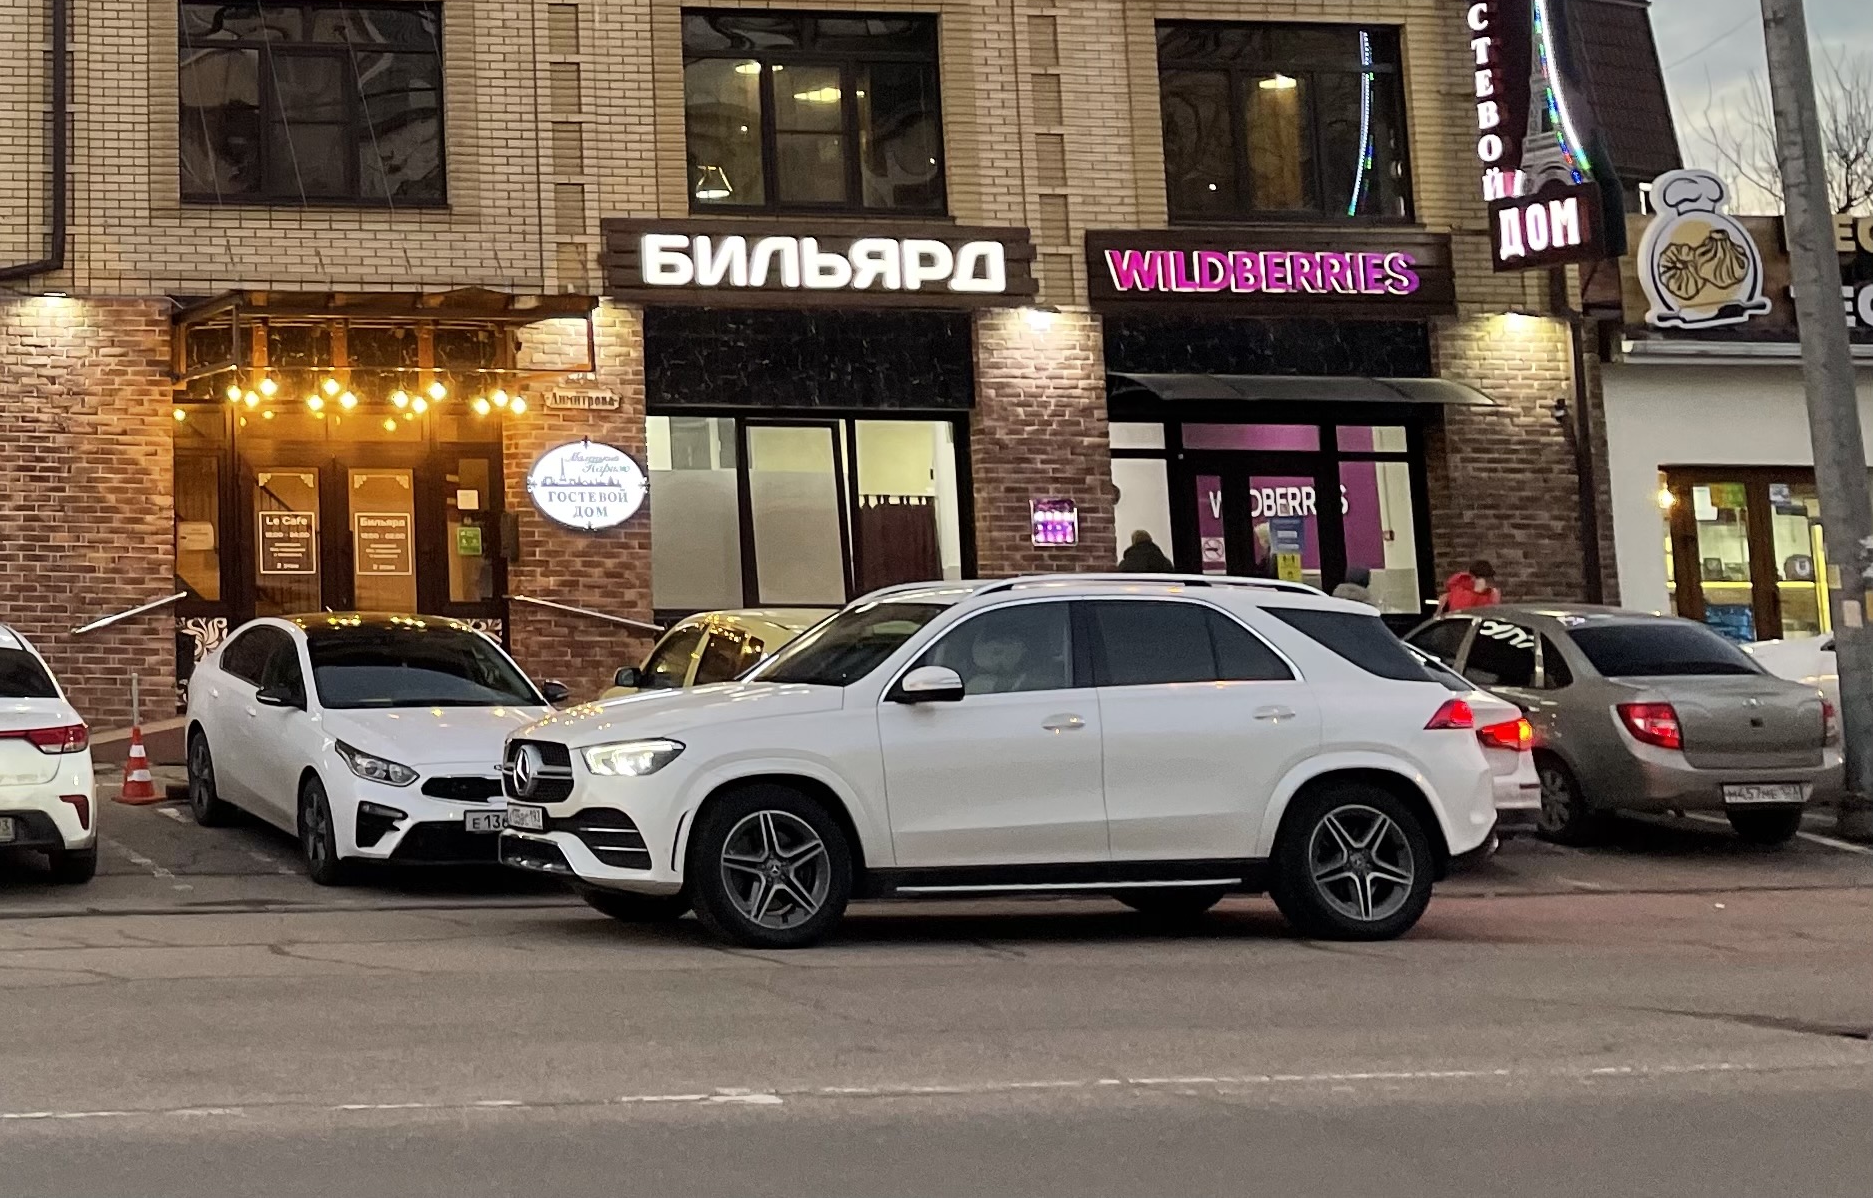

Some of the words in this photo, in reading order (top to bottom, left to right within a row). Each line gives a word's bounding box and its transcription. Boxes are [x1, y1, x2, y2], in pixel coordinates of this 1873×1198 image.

[1498, 197, 1581, 261] ДОМ
[641, 233, 1007, 292] БИЛЬЯРД
[1104, 249, 1421, 294] WILDBERRIES
[547, 488, 629, 503] ГОСТЕВОЙ
[573, 506, 609, 519] ДОМ
[265, 515, 280, 526] Le
[281, 515, 308, 526] Cafe
[359, 517, 406, 528] Бильярд
[472, 814, 508, 830] Е136
